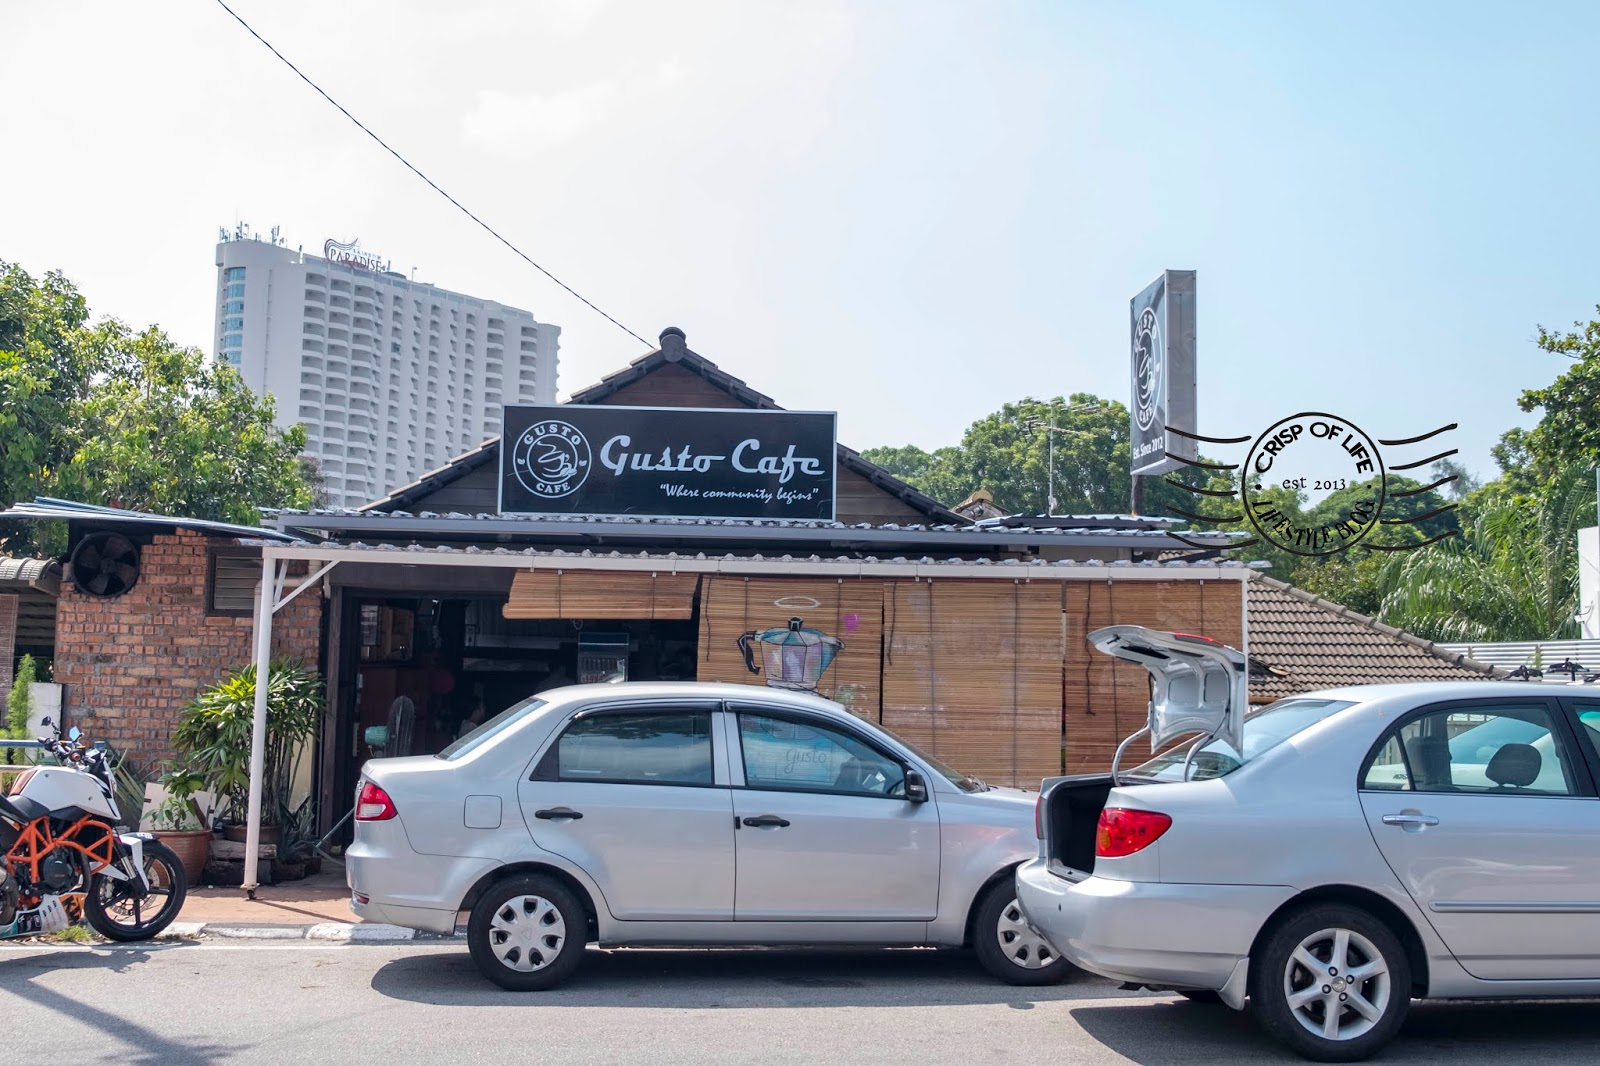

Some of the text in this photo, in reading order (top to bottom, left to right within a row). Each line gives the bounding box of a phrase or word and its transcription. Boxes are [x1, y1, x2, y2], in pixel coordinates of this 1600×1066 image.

[330, 248, 382, 272] PARADISE
[524, 424, 581, 445] GUSTO
[600, 435, 826, 484] Gusto Cafe
[536, 482, 571, 494] CAFE
[702, 488, 773, 504] community
